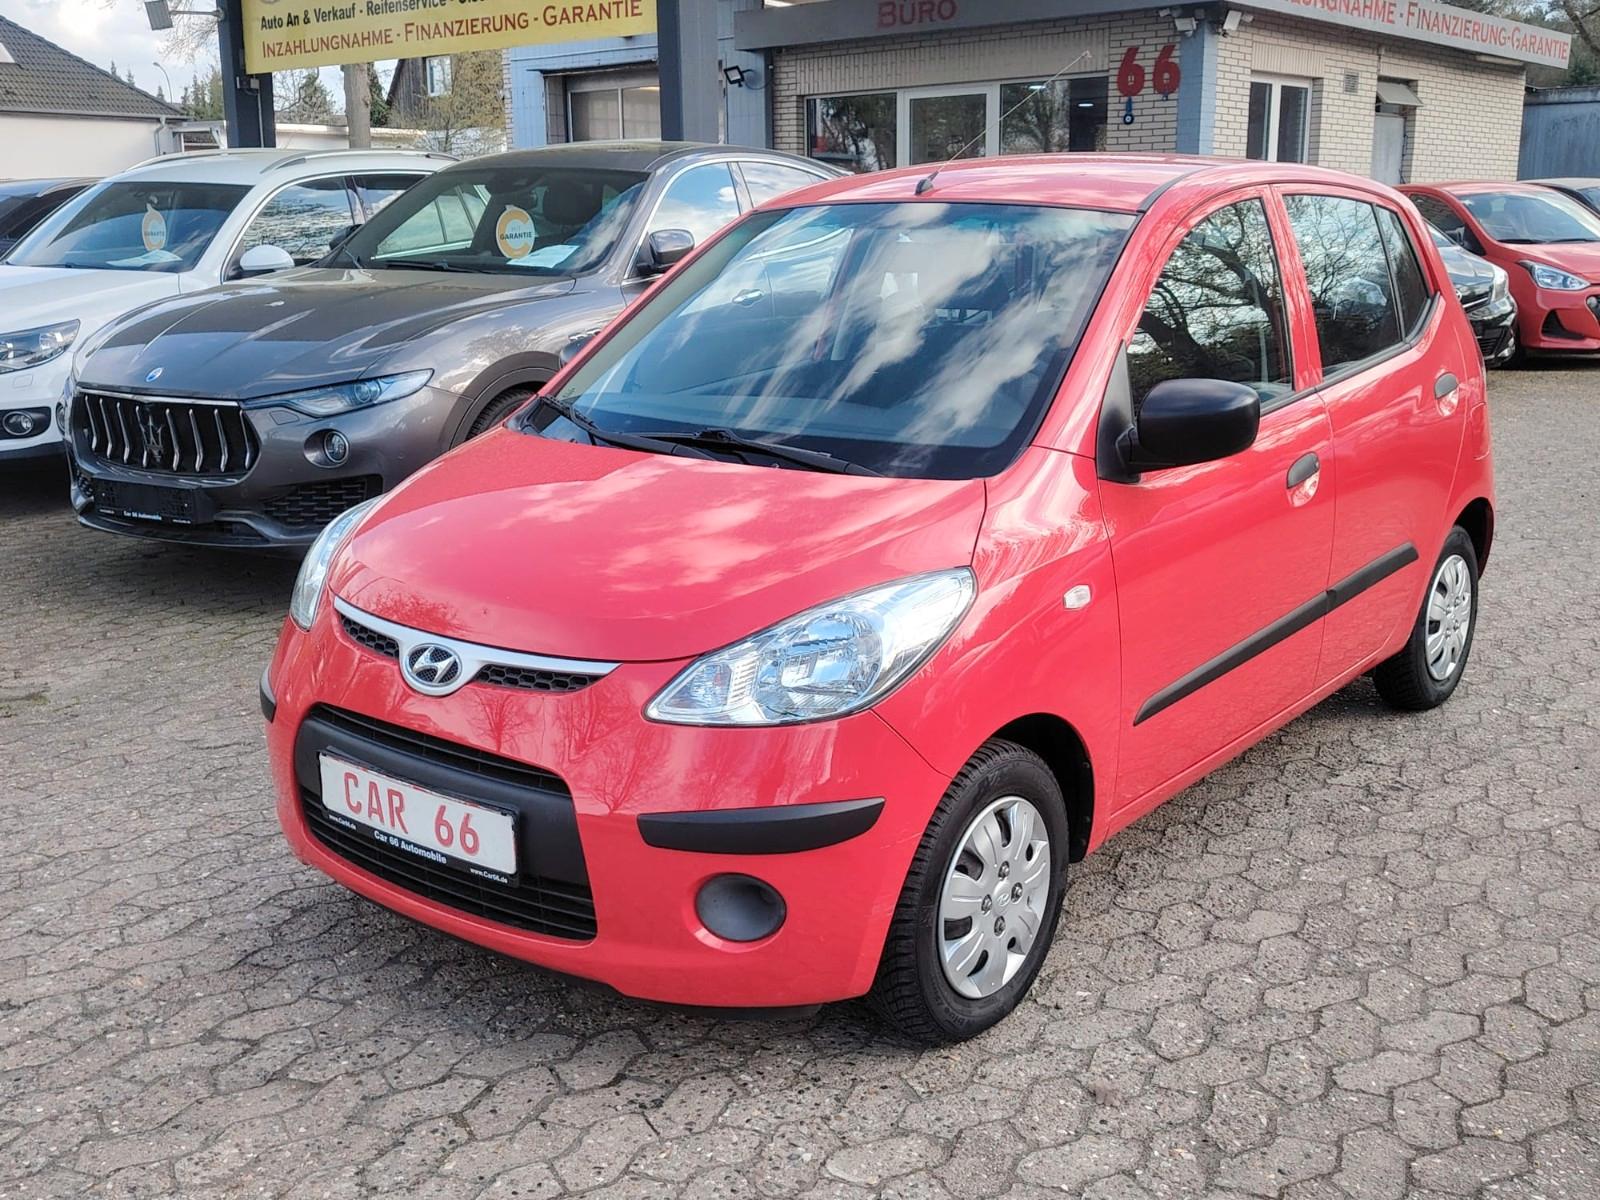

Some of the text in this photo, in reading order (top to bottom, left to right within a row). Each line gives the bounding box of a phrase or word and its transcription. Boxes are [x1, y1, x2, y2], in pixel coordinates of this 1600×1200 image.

[261, 15, 284, 31] Auto
[286, 12, 300, 27] An
[303, 10, 311, 25] &
[314, 3, 357, 23] Verkauf
[262, 28, 394, 59] INZAHLUNGNAHME
[404, 12, 529, 42] FINANZIERUNG
[543, 0, 643, 26] GARANTIE
[1116, 44, 1181, 97] 66
[500, 231, 532, 241] GARANTIE
[344, 772, 480, 856] CAR 66
[373, 830, 447, 864] Car 66 Automobile
